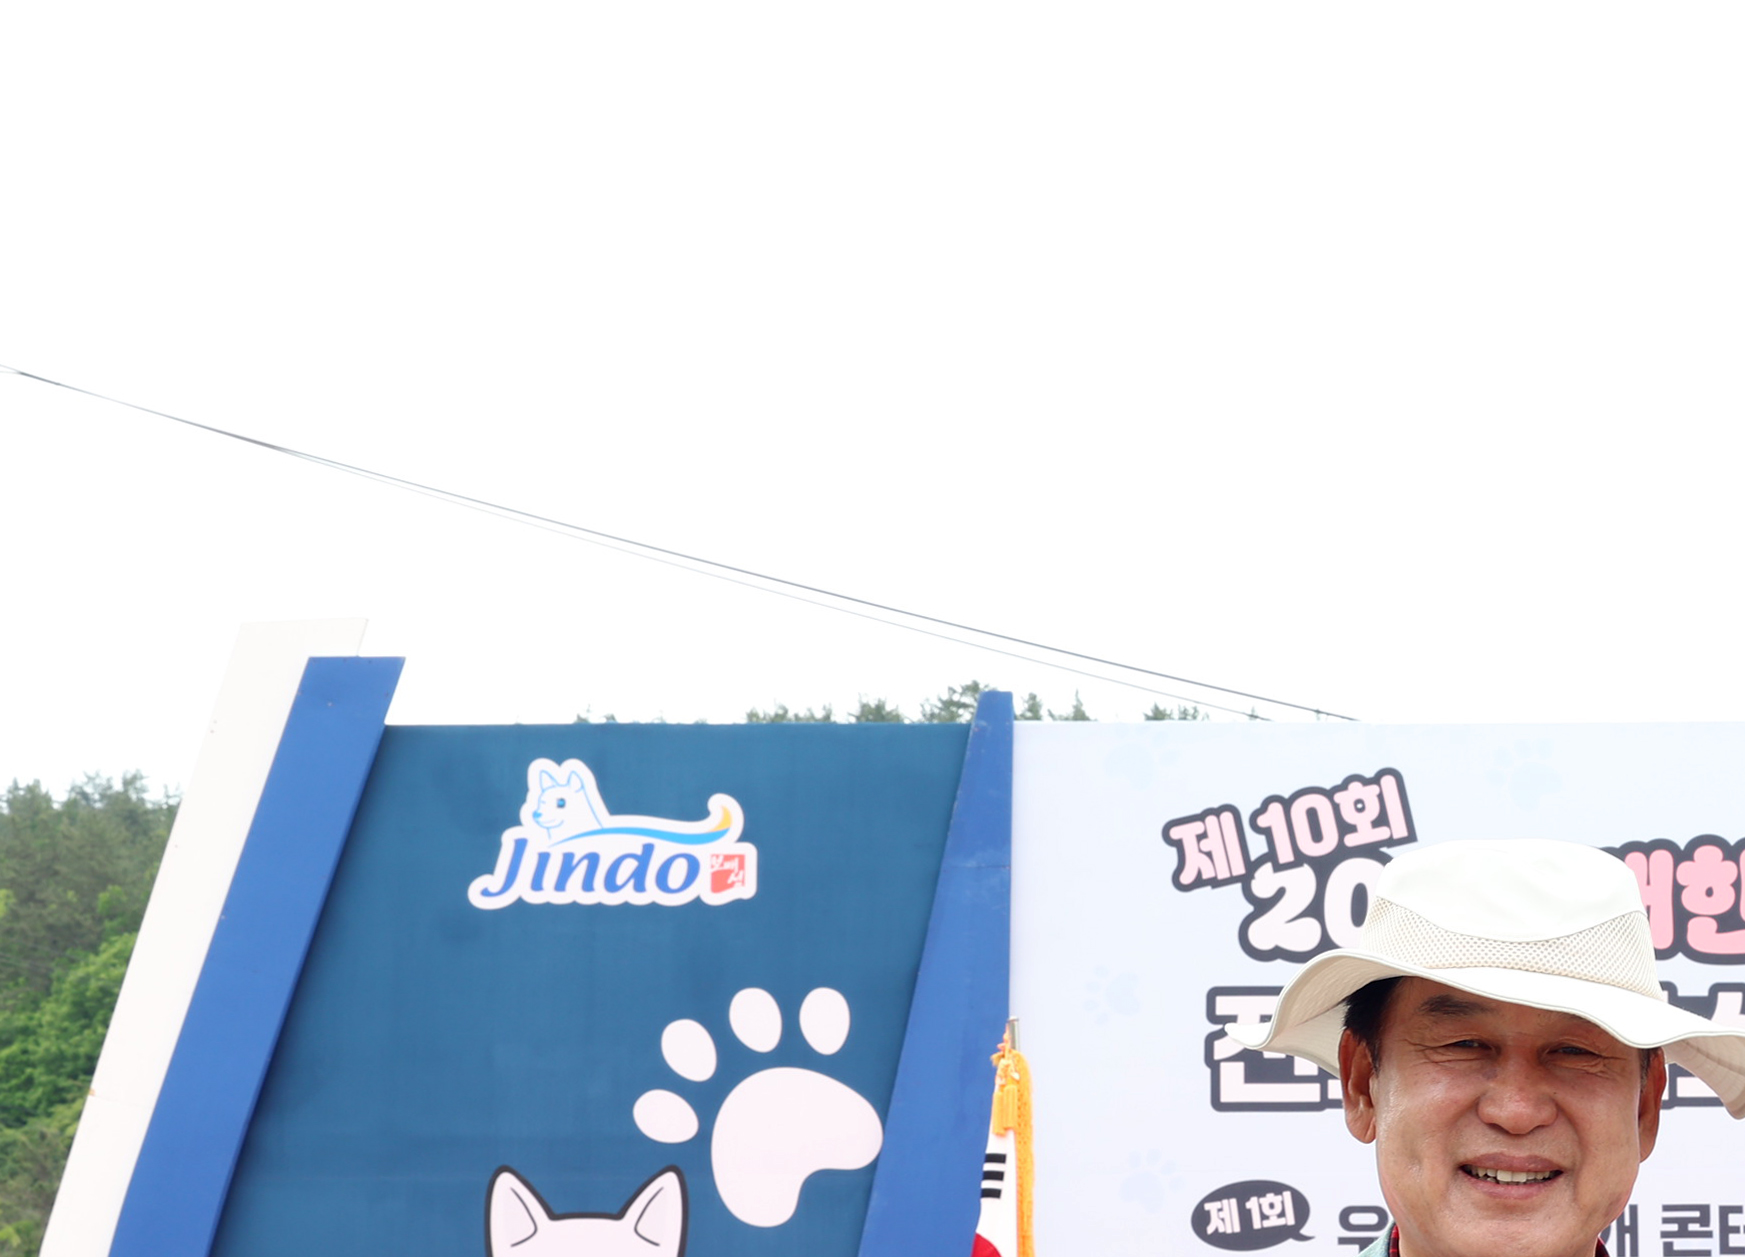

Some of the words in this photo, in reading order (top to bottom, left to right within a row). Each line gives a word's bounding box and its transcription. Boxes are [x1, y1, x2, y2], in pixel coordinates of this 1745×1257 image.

[479, 837, 701, 898] Jindo
[1168, 810, 1247, 886] 제
[1255, 774, 1410, 865] 10회
[1247, 856, 1388, 953] 20
[1203, 1197, 1242, 1236] 제
[1245, 1190, 1296, 1231] 1회
